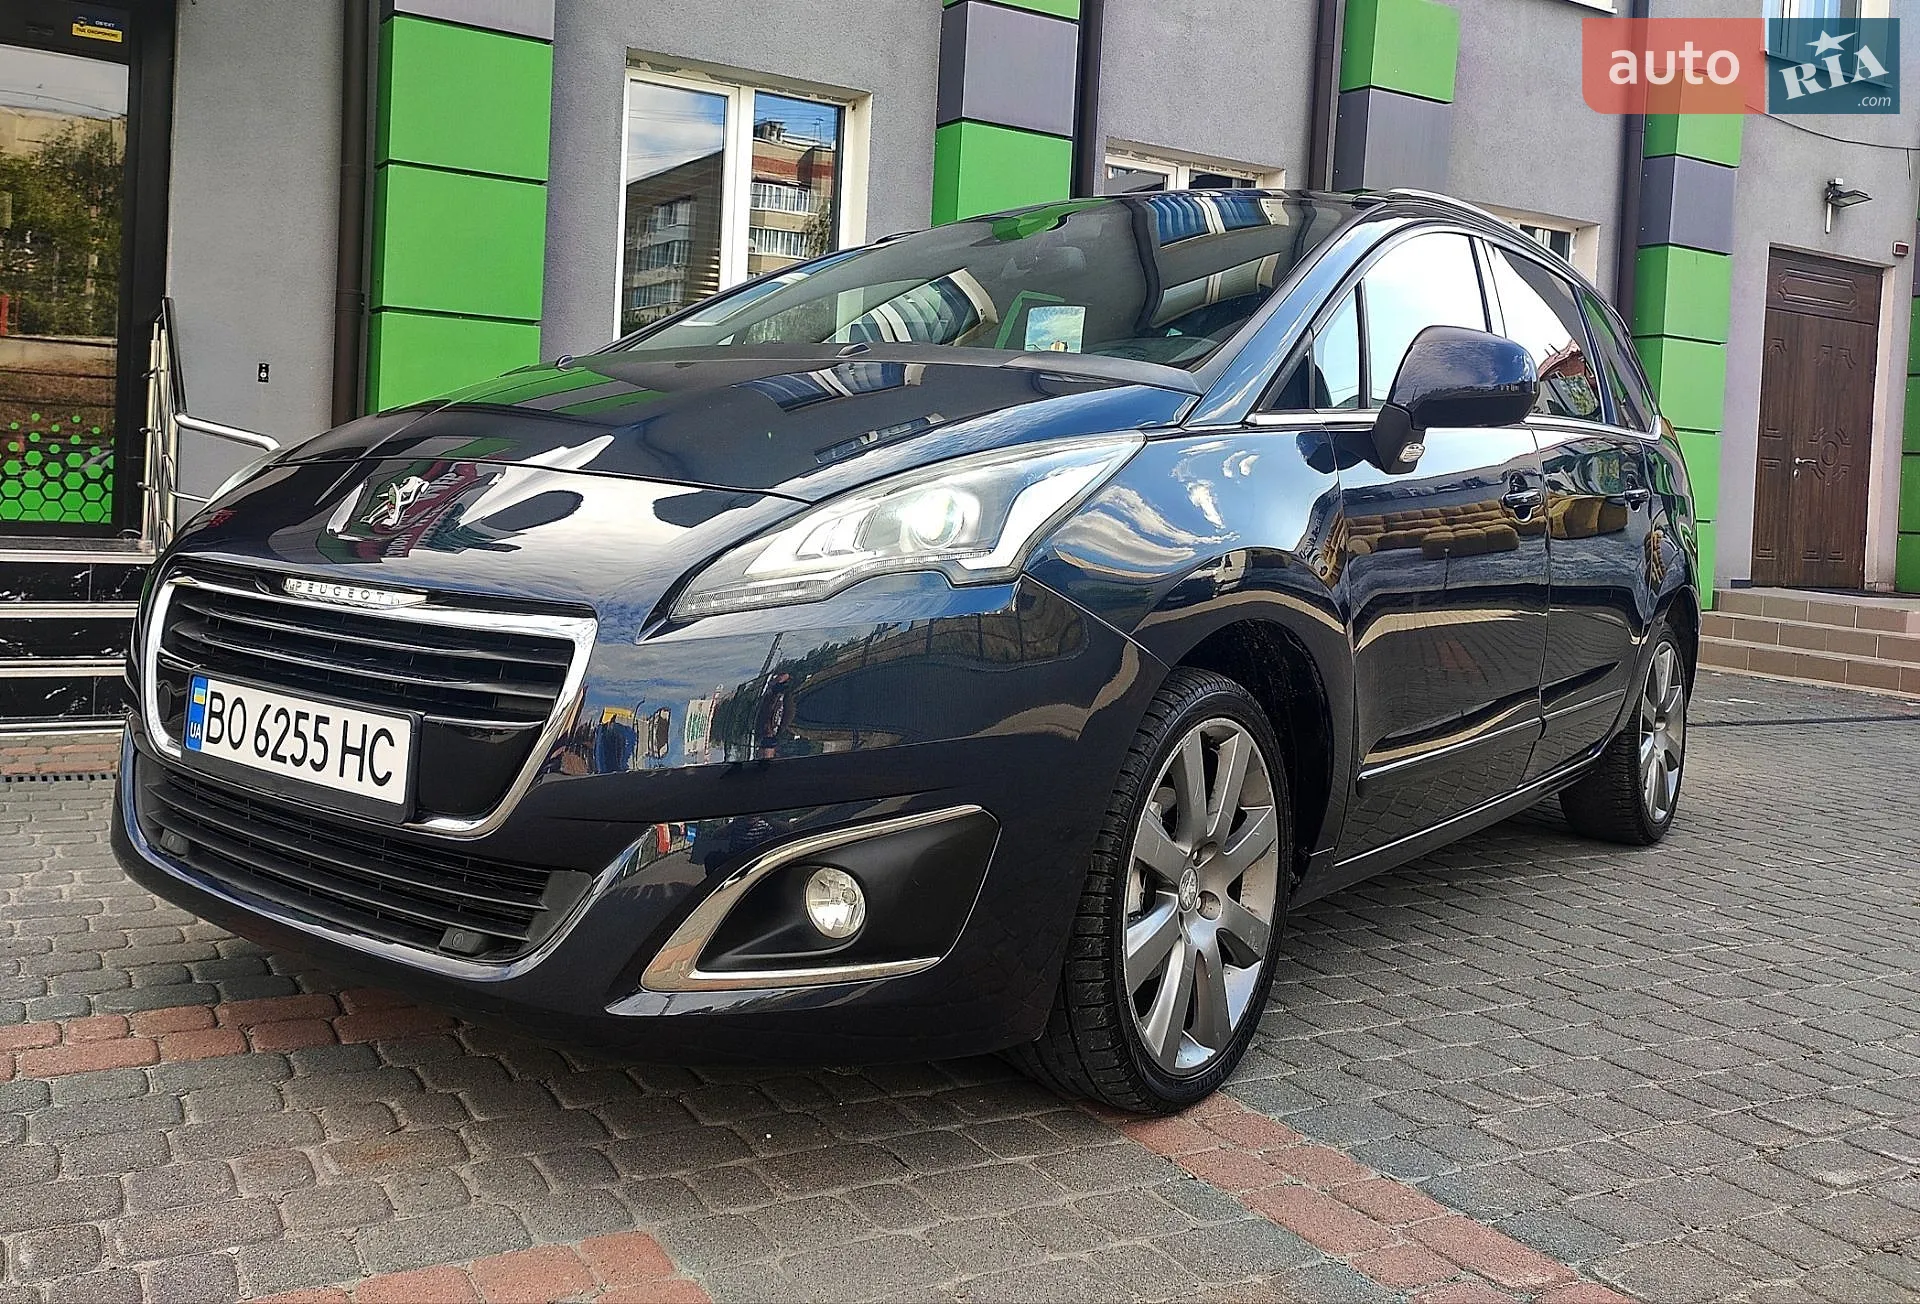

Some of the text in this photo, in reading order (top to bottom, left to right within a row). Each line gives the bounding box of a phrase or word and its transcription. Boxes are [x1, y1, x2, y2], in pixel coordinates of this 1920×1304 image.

[295, 580, 385, 602] PEUGEOT
[190, 719, 202, 740] UA
[205, 690, 395, 787] BO 6255 HC
